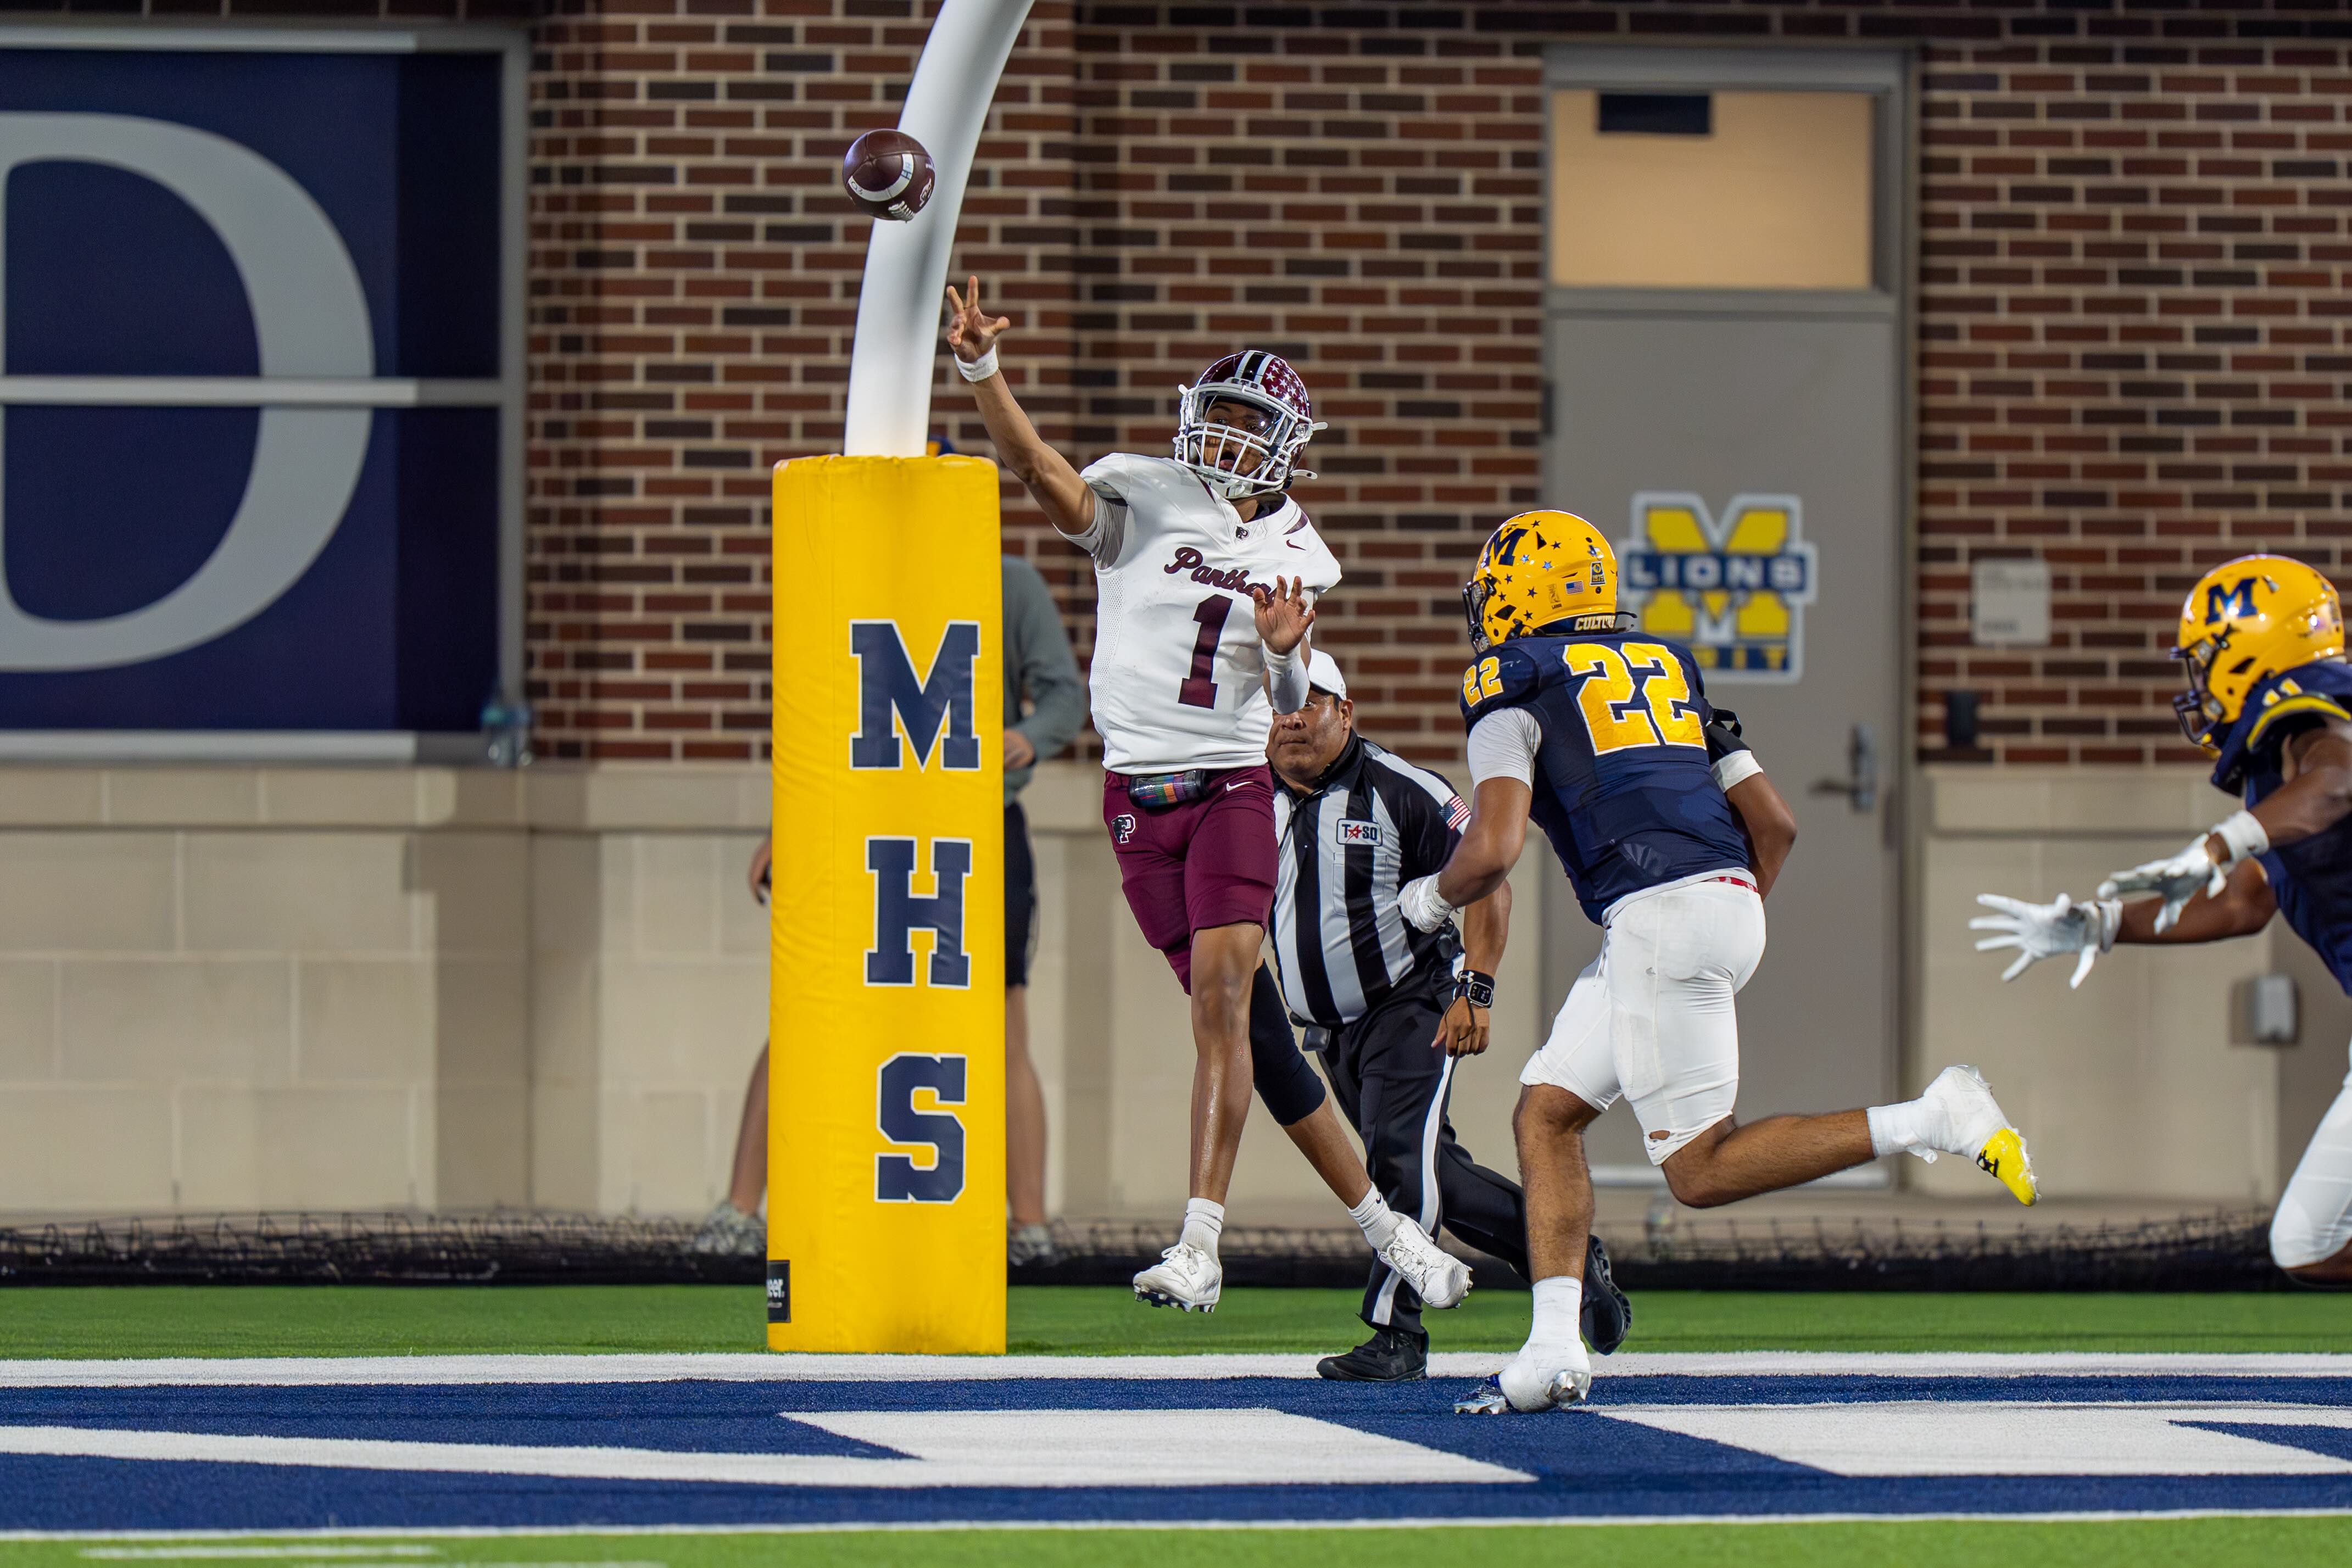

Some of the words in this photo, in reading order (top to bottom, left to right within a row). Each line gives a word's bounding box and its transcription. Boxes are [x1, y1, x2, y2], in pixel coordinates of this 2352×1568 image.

[1480, 528, 1529, 568] M
[1628, 555, 1803, 589] LIONS
[2205, 577, 2258, 626] M
[1178, 592, 1234, 710] 1
[1463, 656, 1504, 708] 22
[1563, 642, 1707, 757] 22
